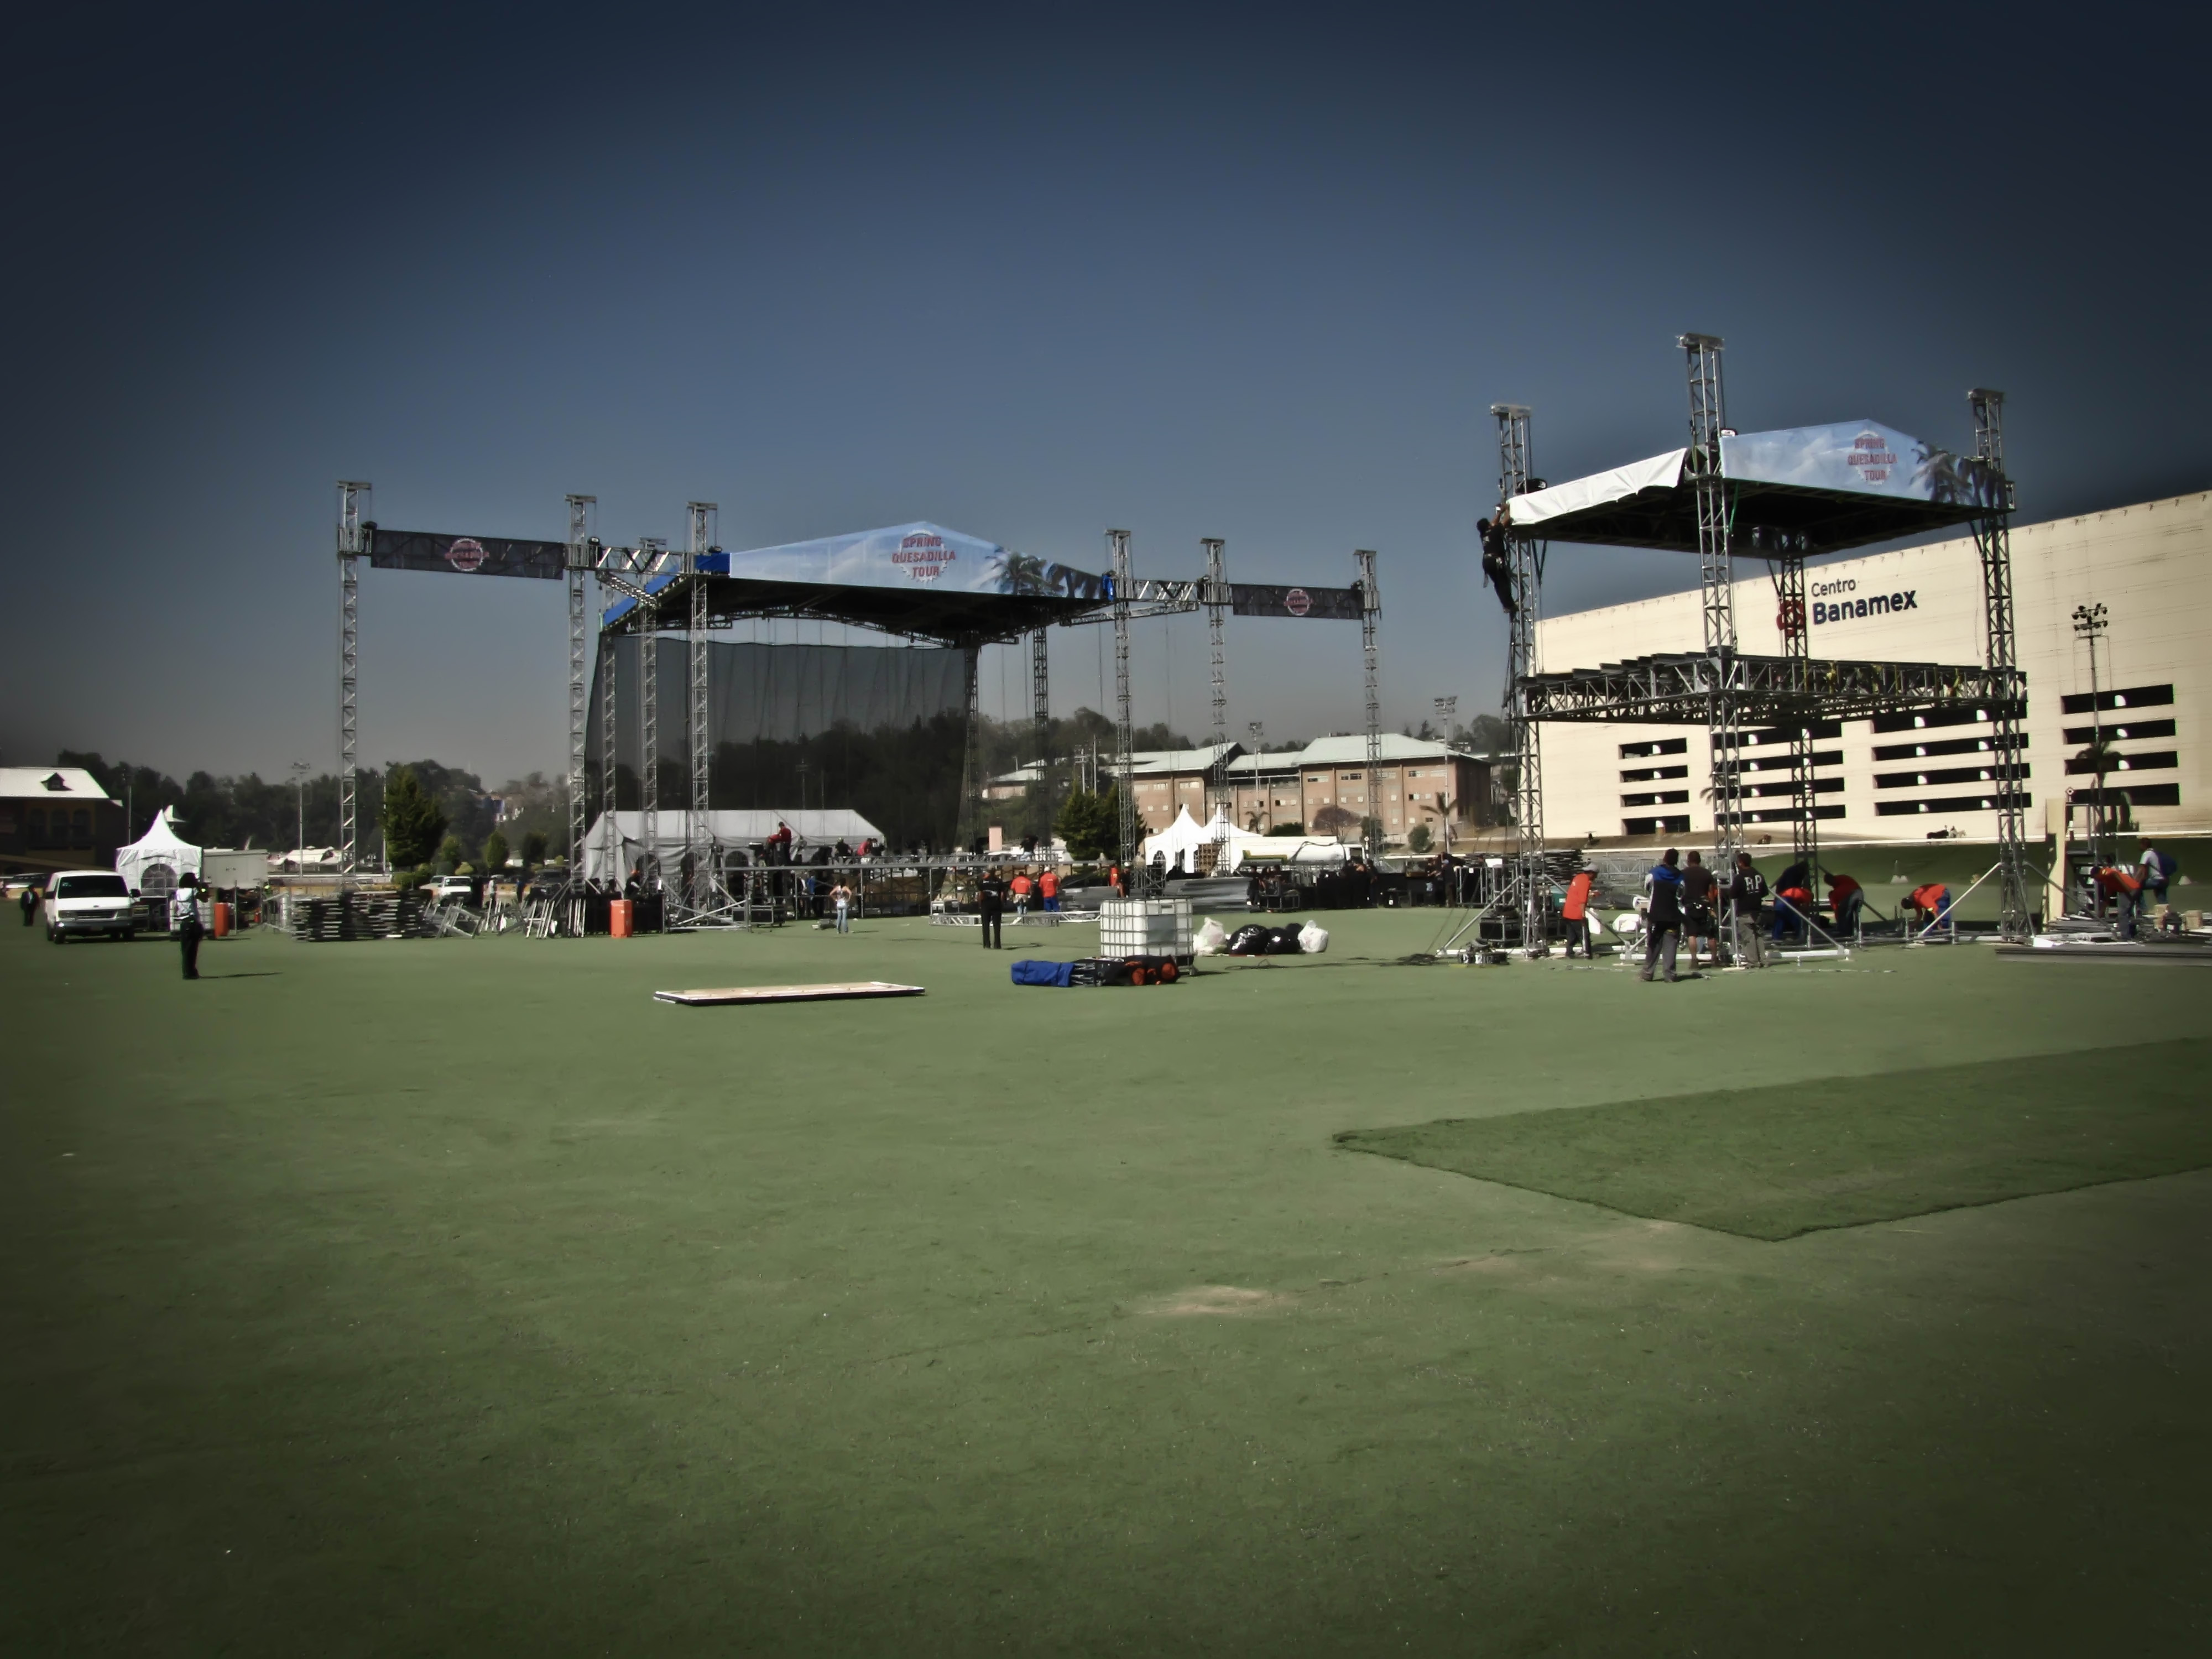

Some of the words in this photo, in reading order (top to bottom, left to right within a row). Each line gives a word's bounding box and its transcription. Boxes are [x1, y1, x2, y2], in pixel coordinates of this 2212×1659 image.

[1864, 470, 1886, 481] TOUR
[902, 536, 942, 547] SPRING
[892, 550, 956, 563] QUESADILLA
[912, 565, 940, 578] TOUR
[1811, 578, 1856, 597] Centro
[1813, 590, 1918, 625] Banamex
